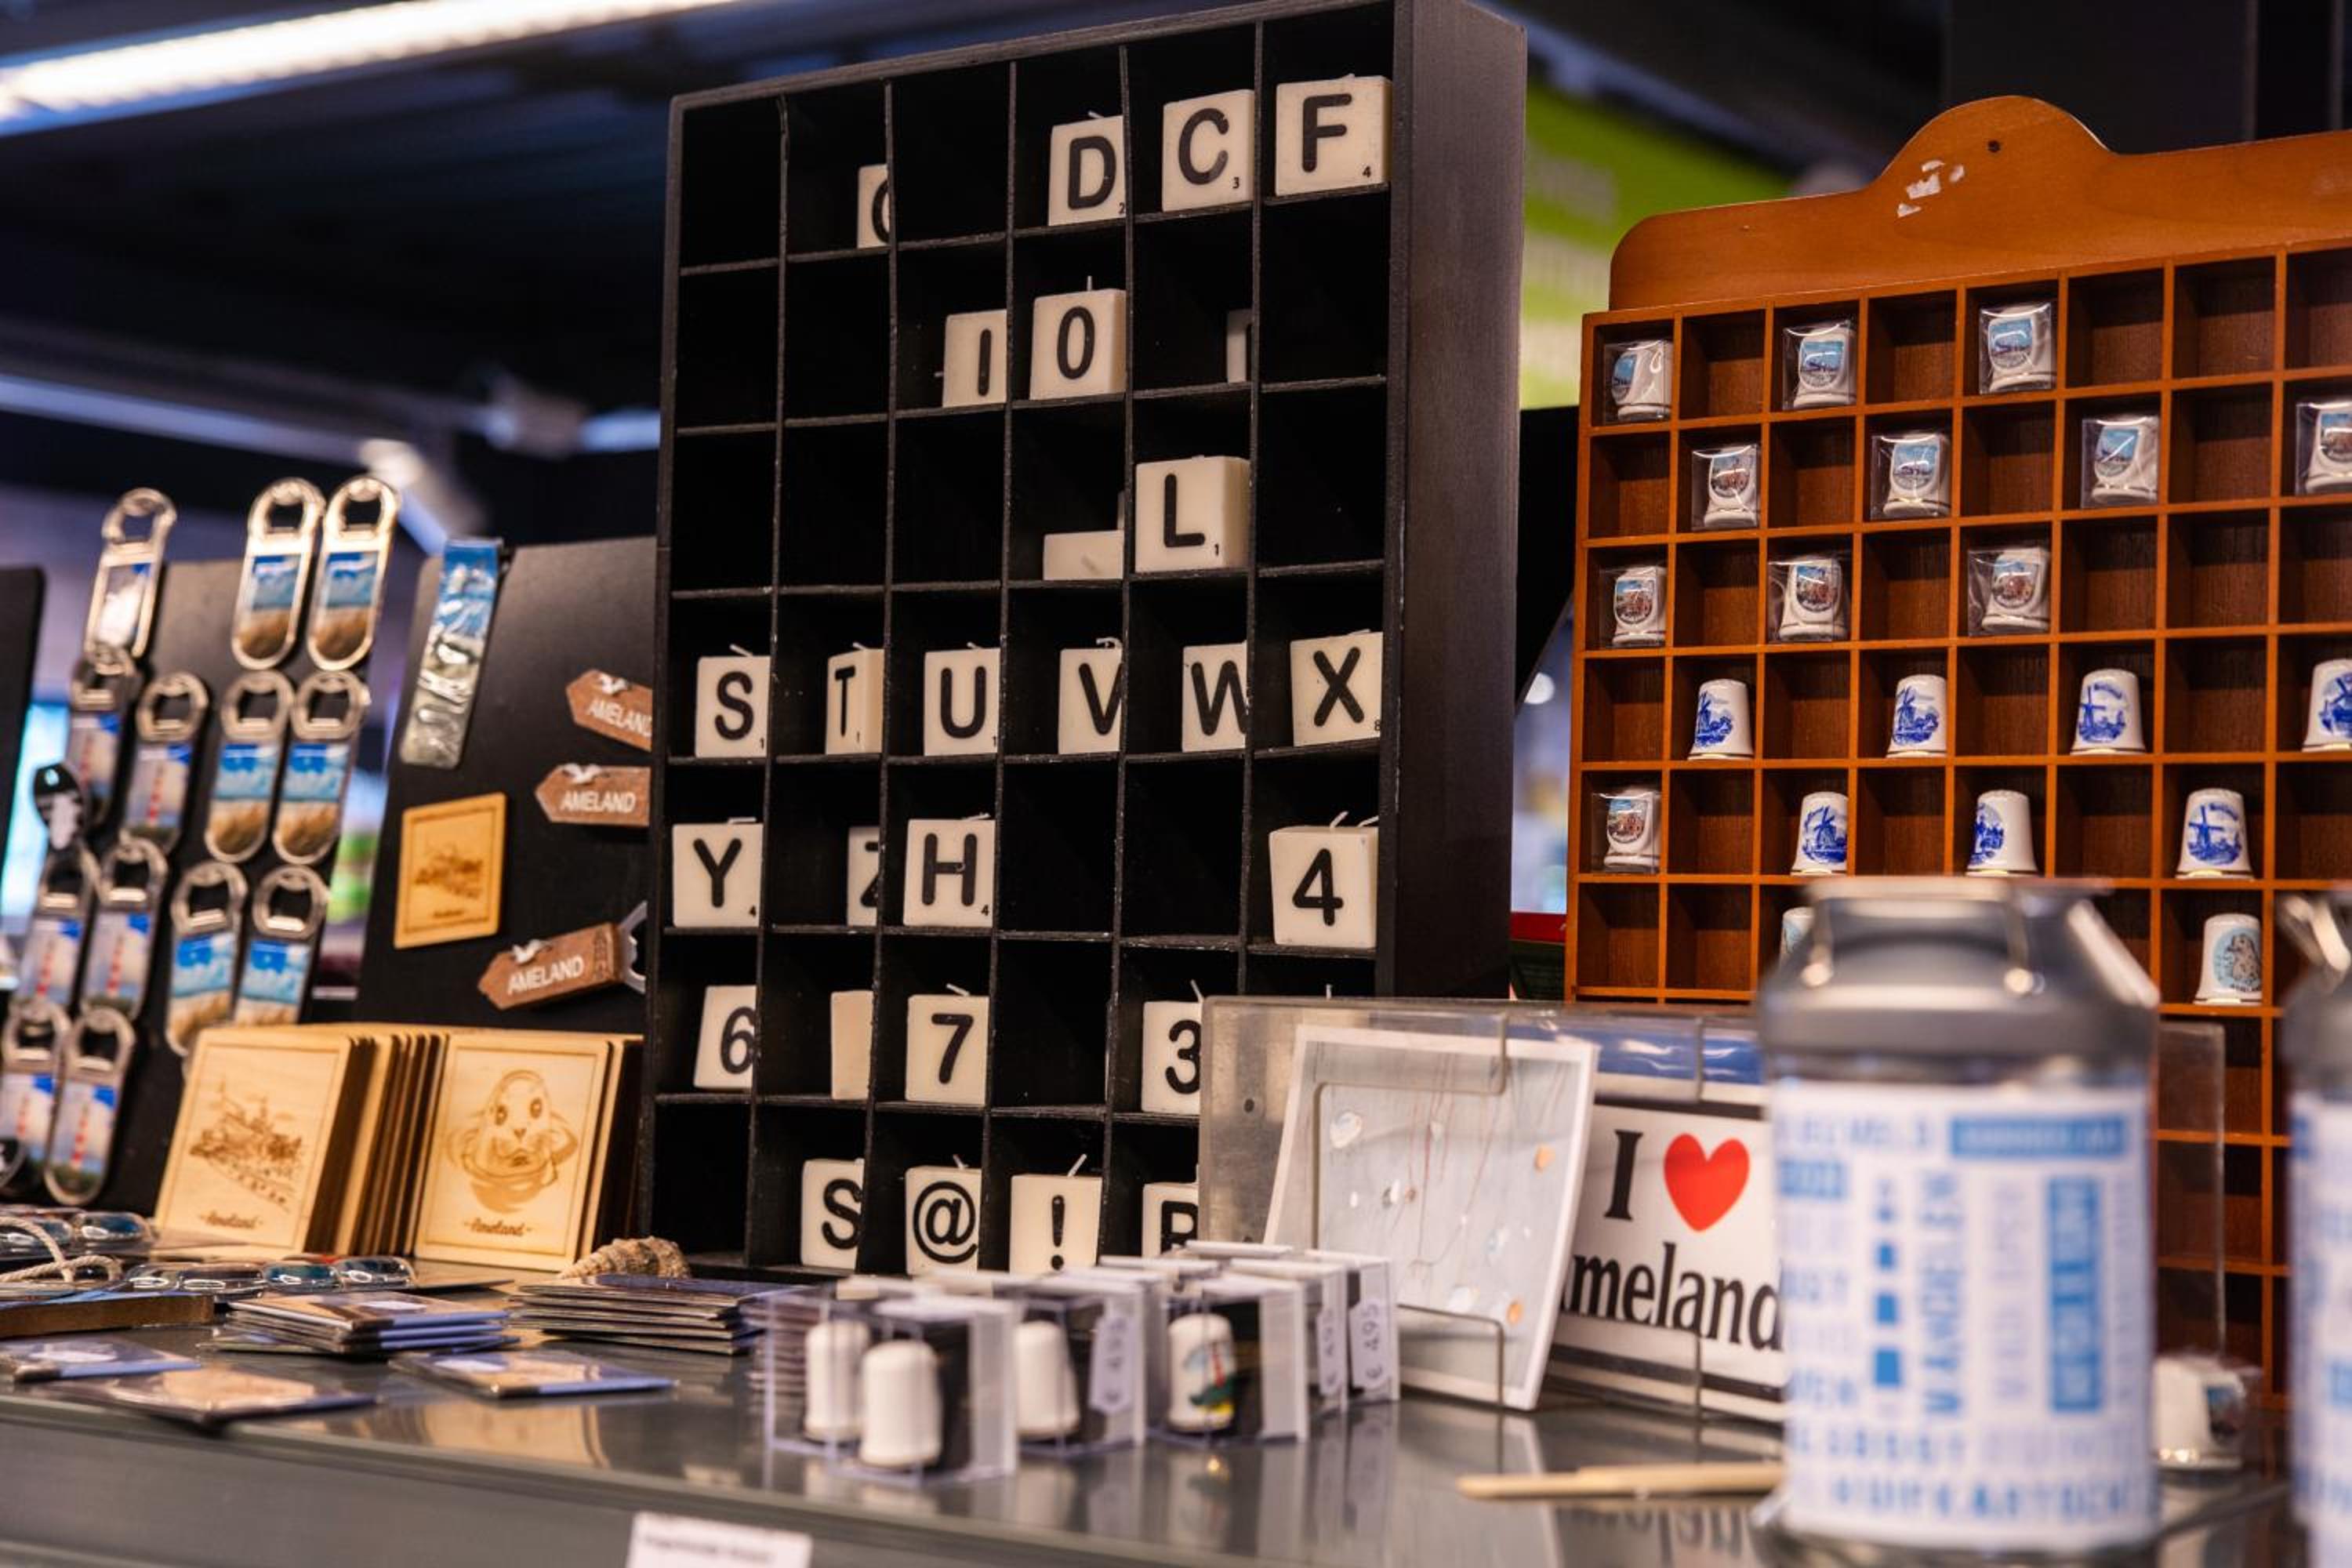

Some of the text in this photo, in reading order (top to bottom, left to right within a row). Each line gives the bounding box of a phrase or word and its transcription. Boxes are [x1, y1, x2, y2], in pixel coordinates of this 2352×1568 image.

[1178, 107, 1229, 186] C
[1301, 93, 1352, 173] F
[1068, 136, 1116, 210] D
[1232, 177, 1240, 190] 3
[1363, 165, 1372, 178] 4
[1163, 473, 1206, 548] L
[714, 671, 754, 741] S
[834, 665, 856, 737] T
[940, 666, 987, 739] U
[1078, 662, 1122, 736] V
[1191, 660, 1248, 737] W
[1312, 647, 1365, 728] X
[560, 790, 637, 814] AMELAND
[693, 838, 742, 908] Y
[922, 833, 978, 906] H
[1292, 848, 1344, 927] 4
[749, 906, 757, 917] 4
[981, 905, 990, 916] 4
[506, 954, 585, 995] AMELAND
[720, 1007, 755, 1074] 6
[931, 1013, 974, 1084] 7
[1165, 1019, 1201, 1094] 3
[1603, 1129, 1643, 1221] I
[822, 1178, 862, 1250] S
[913, 1181, 978, 1264] @
[1051, 1195, 1065, 1271] !
[1561, 1241, 1784, 1352] meland
